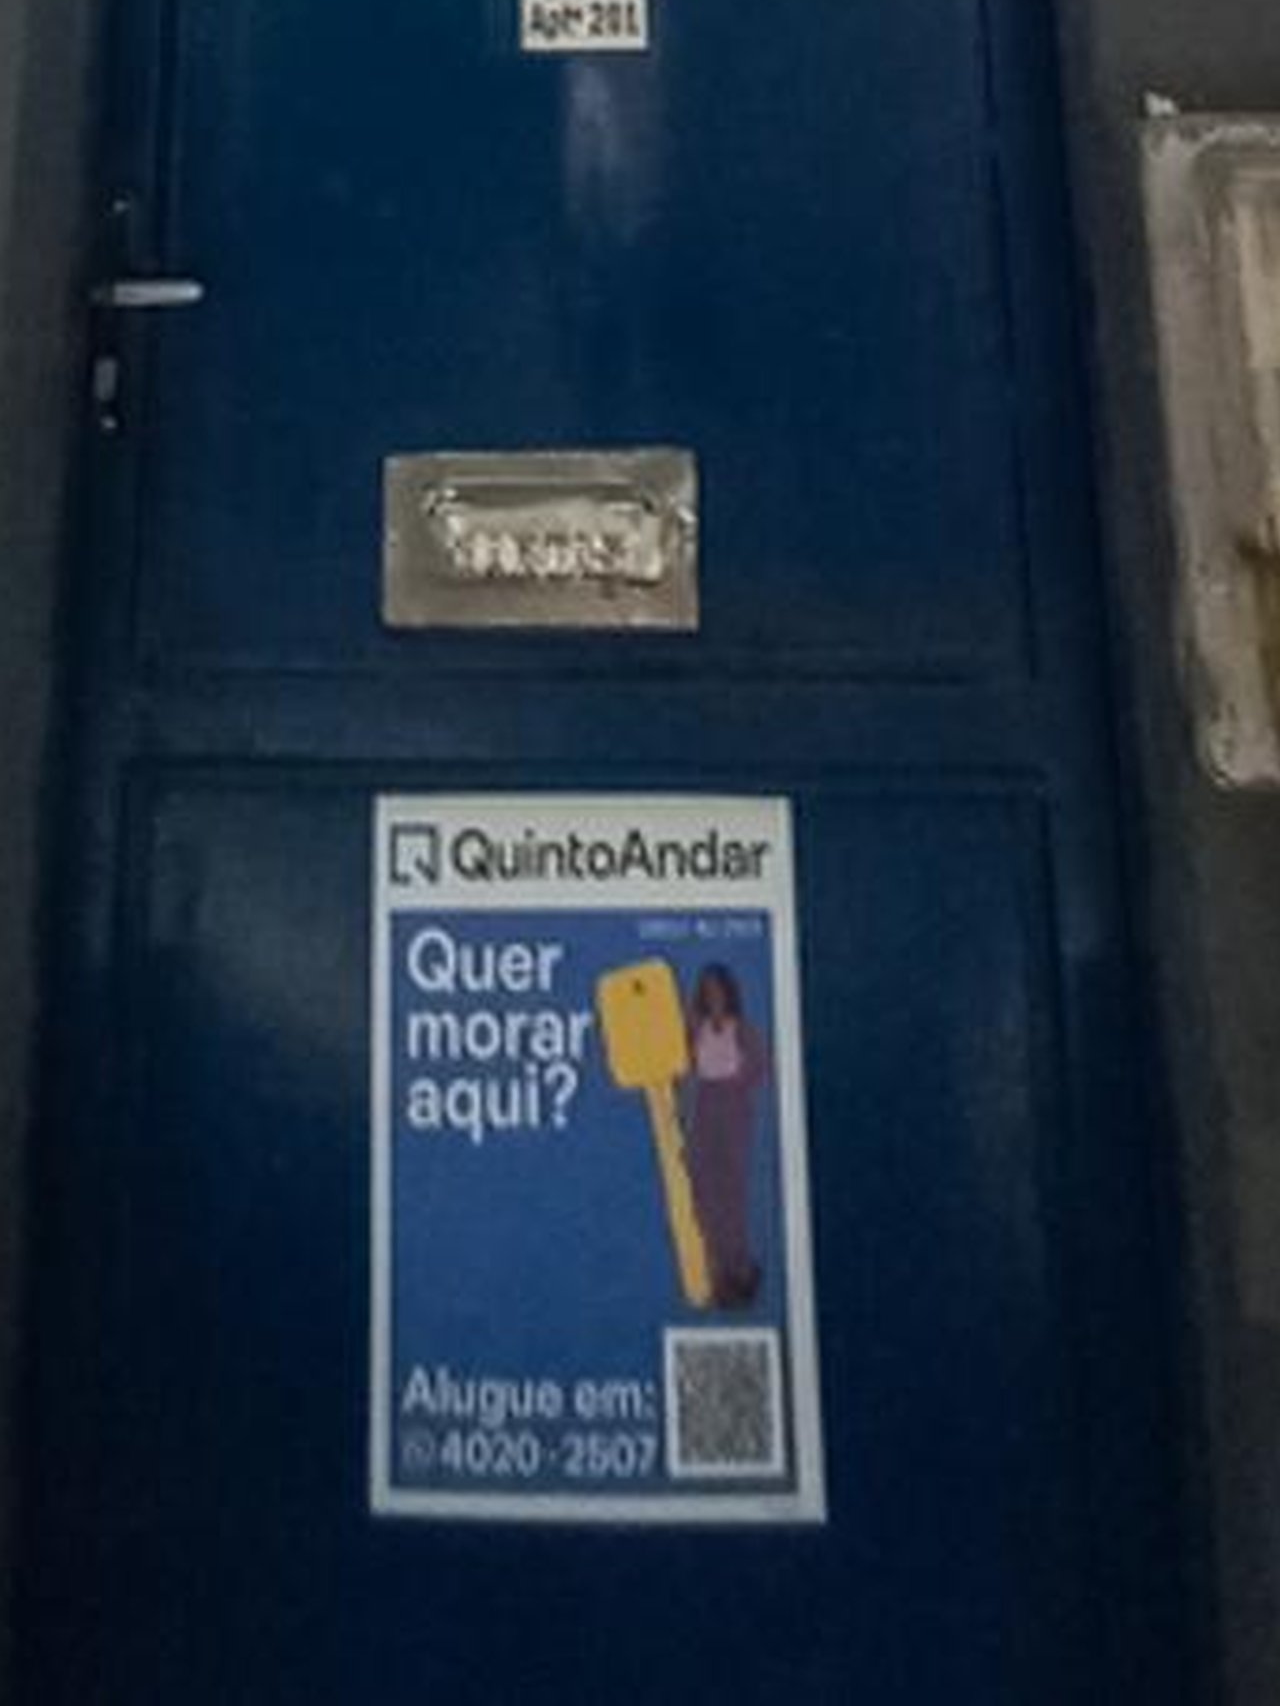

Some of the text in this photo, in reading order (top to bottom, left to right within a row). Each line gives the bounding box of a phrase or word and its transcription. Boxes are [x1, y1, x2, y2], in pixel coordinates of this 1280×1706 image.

[588, 1, 641, 37] 201
[450, 826, 770, 881] QuintoAndar
[407, 927, 564, 993] Quer
[407, 1010, 592, 1060] morar
[407, 1062, 578, 1146] aqui?
[402, 1365, 657, 1431] Alugue em:
